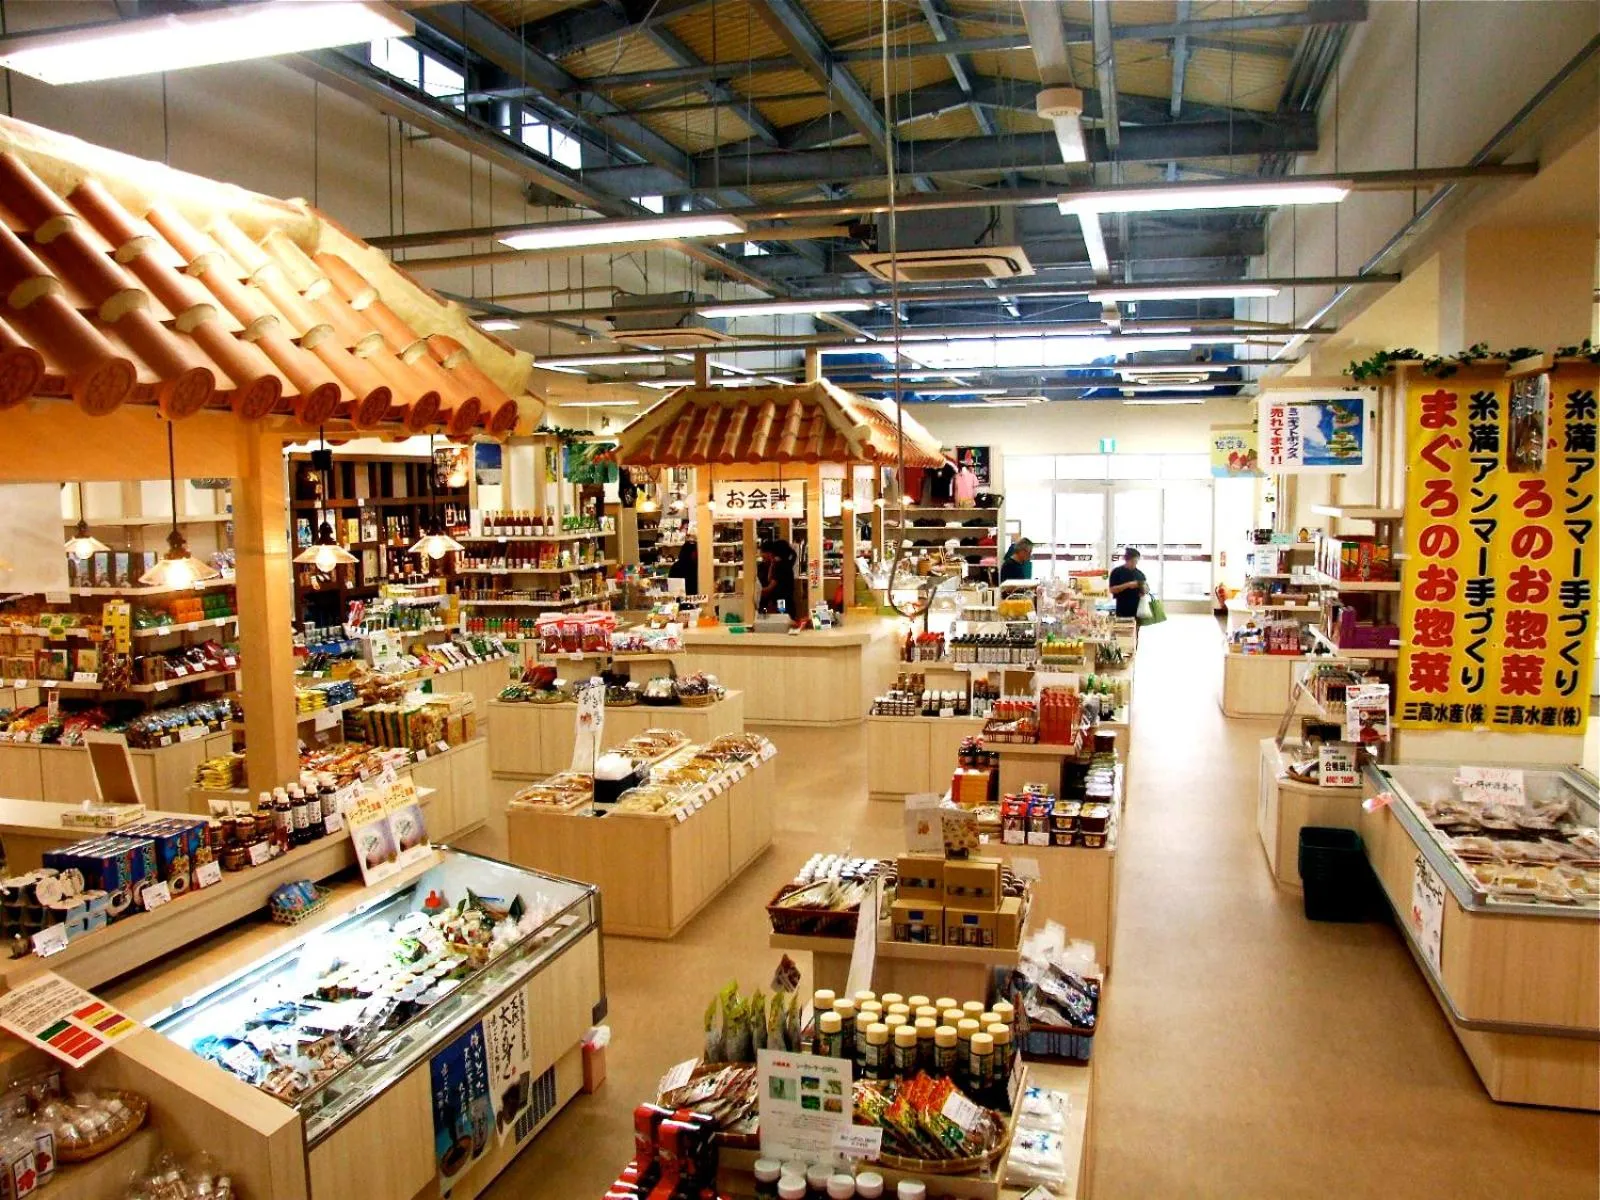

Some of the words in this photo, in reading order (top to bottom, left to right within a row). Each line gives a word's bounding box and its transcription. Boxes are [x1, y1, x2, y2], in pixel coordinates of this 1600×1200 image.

[726, 487, 791, 510] お会計
[1408, 388, 1463, 695] まぐろのお惣菜
[1461, 390, 1500, 694] 糸満アンマー手づくり
[1555, 390, 1598, 697] 糸満アンマー手づくり
[1402, 701, 1487, 724] 三高水産(株
[1493, 704, 1582, 727] 三高水産(株)
